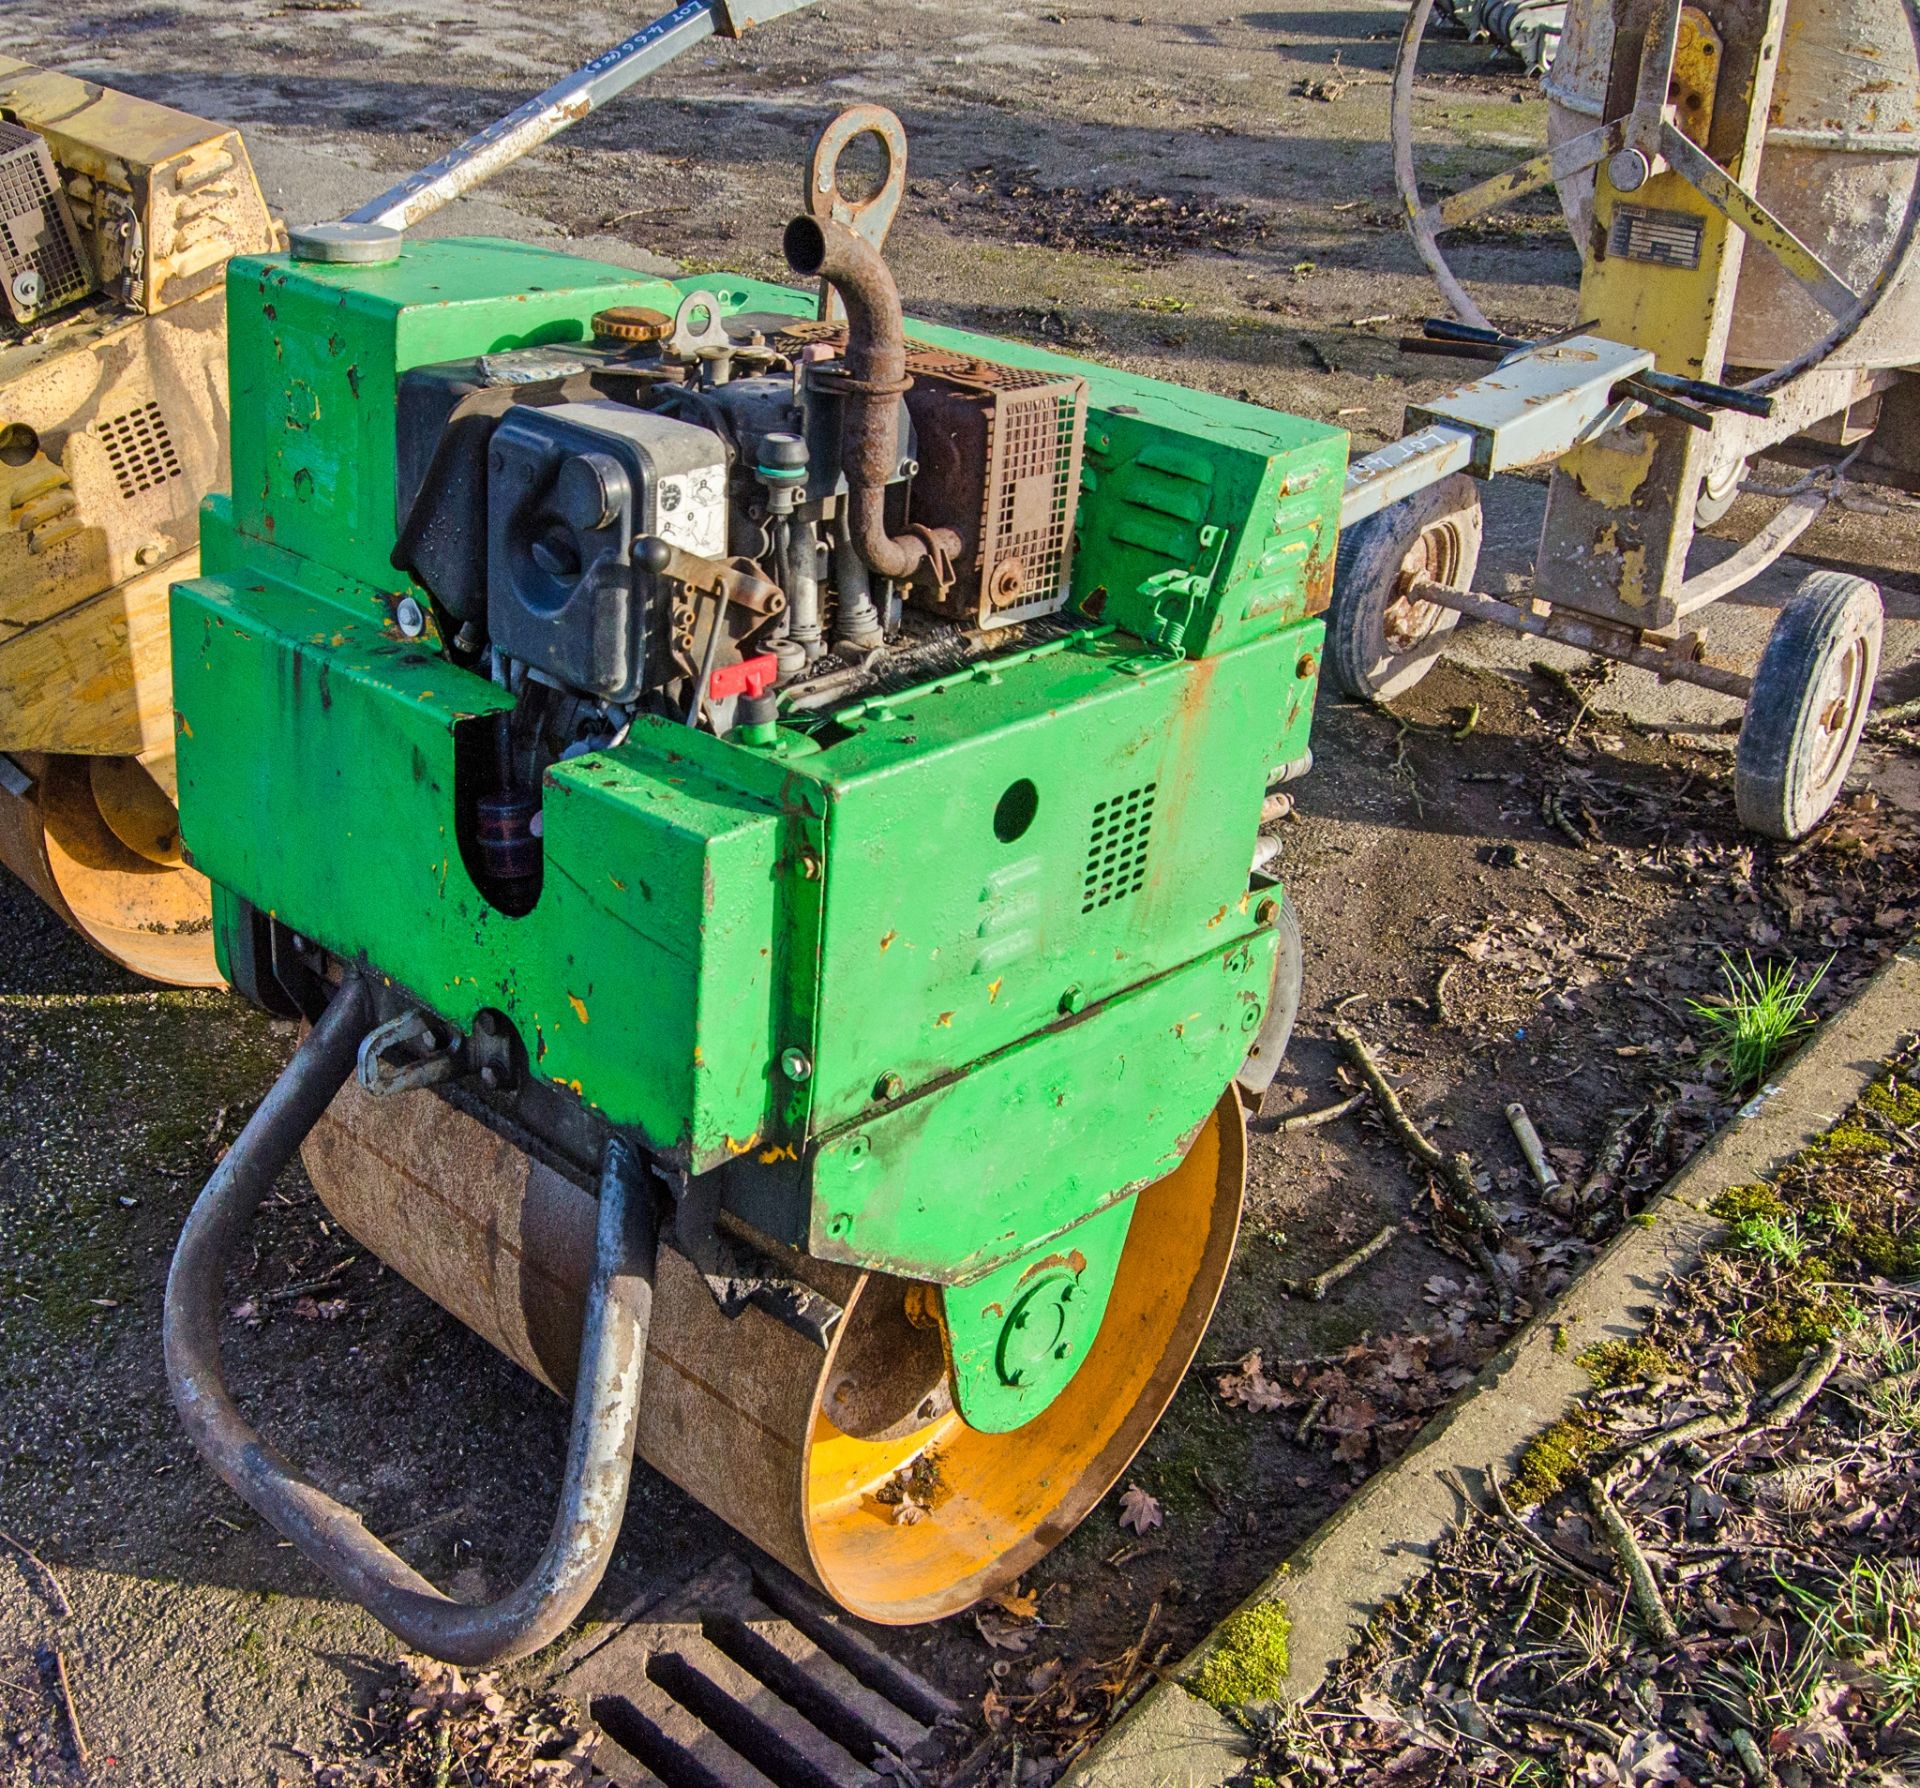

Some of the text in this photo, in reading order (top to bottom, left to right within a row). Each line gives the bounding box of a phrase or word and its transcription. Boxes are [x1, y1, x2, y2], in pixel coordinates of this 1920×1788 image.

[673, 2, 703, 22] LOT
[622, 25, 664, 51] 466
[1398, 433, 1447, 458] LOT
